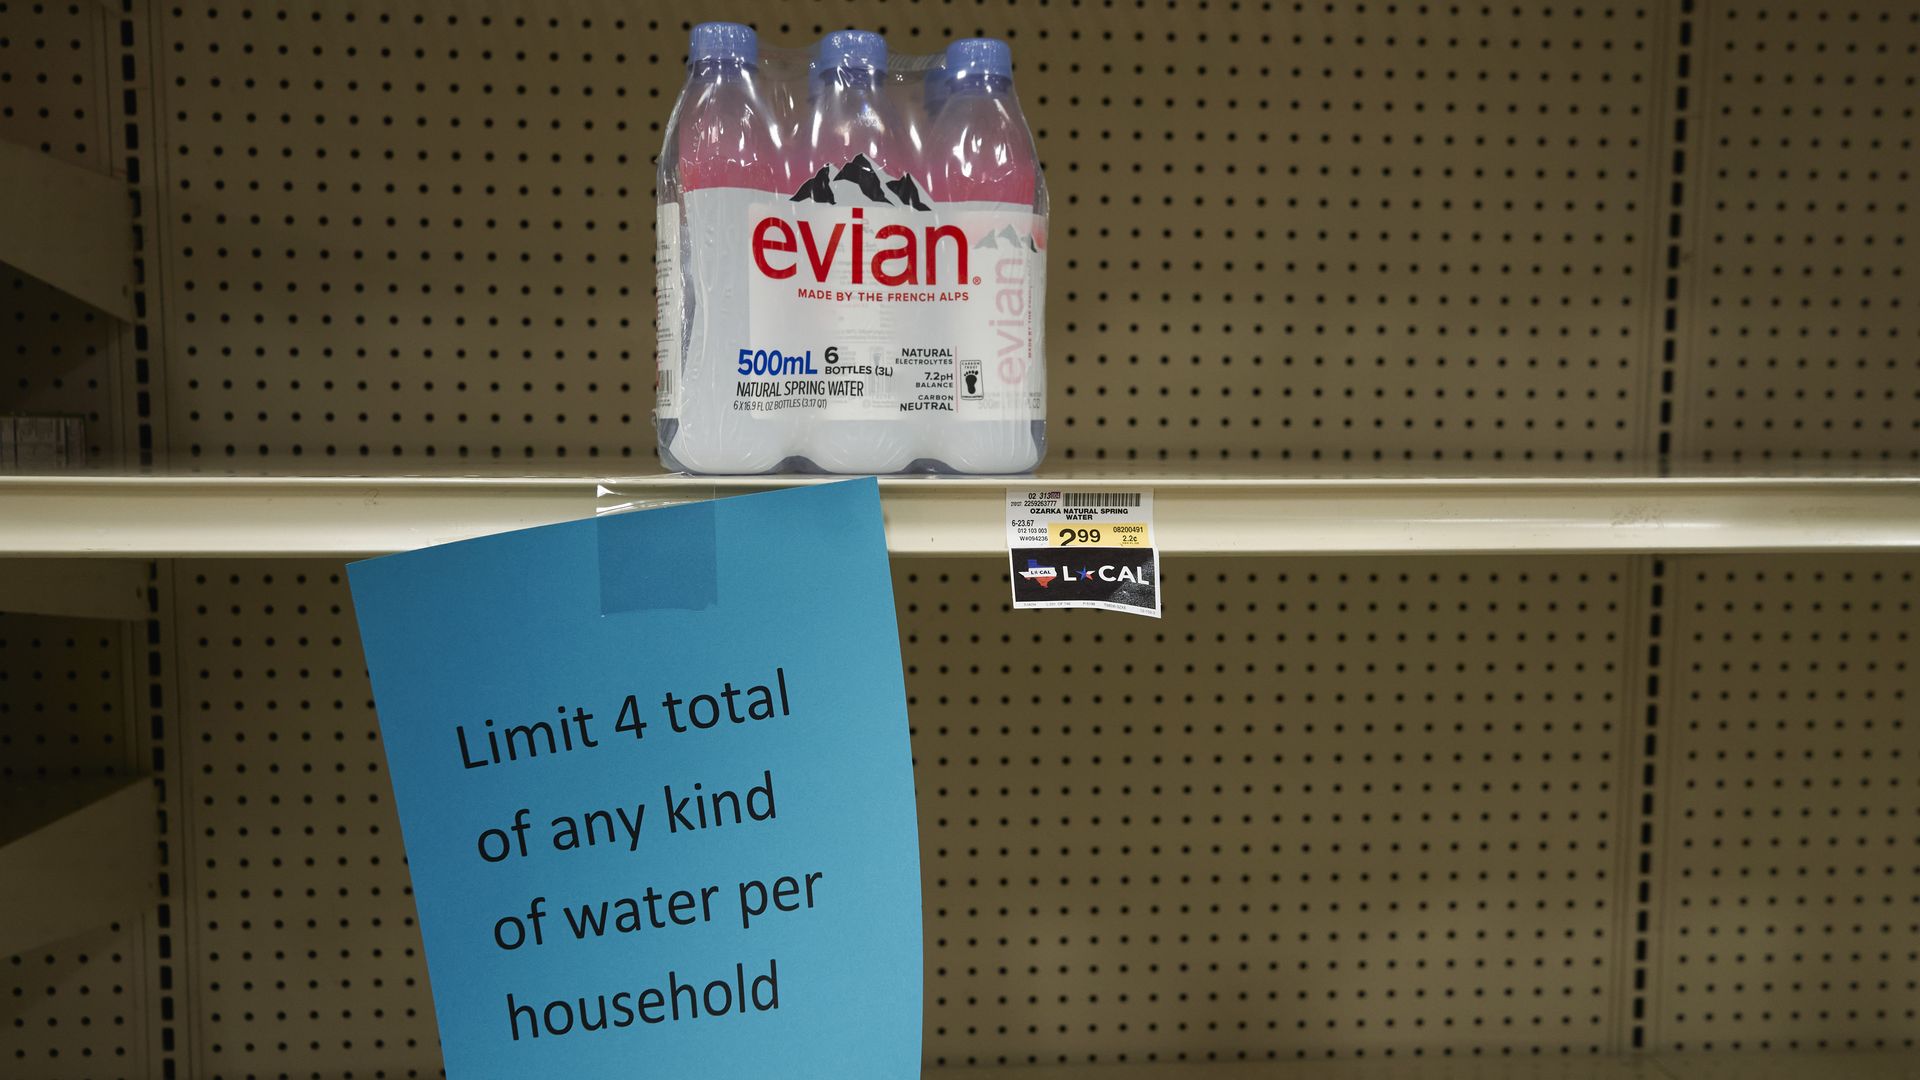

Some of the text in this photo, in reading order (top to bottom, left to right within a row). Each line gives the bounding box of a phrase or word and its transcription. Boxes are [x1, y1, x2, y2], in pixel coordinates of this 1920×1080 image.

[752, 208, 968, 286] evian
[798, 288, 969, 302] MADE BY THE FRENCH ALPS
[988, 258, 1025, 385] evian
[737, 348, 817, 376] 500mL
[824, 346, 839, 364] 6
[902, 348, 952, 358] NATURAL
[825, 365, 893, 377] BOTTLES (3L)
[924, 372, 953, 382] 7.2pH
[736, 380, 864, 397] NATURAL SPRING WATER
[757, 402, 764, 411] FL
[765, 401, 773, 410] OZ
[774, 399, 800, 410] BOTTLES
[900, 402, 953, 411] NEUTRAL
[456, 667, 791, 769] Limit 4 total
[477, 770, 777, 862] of any kind
[494, 870, 823, 951] of water per
[507, 959, 779, 1041] household
